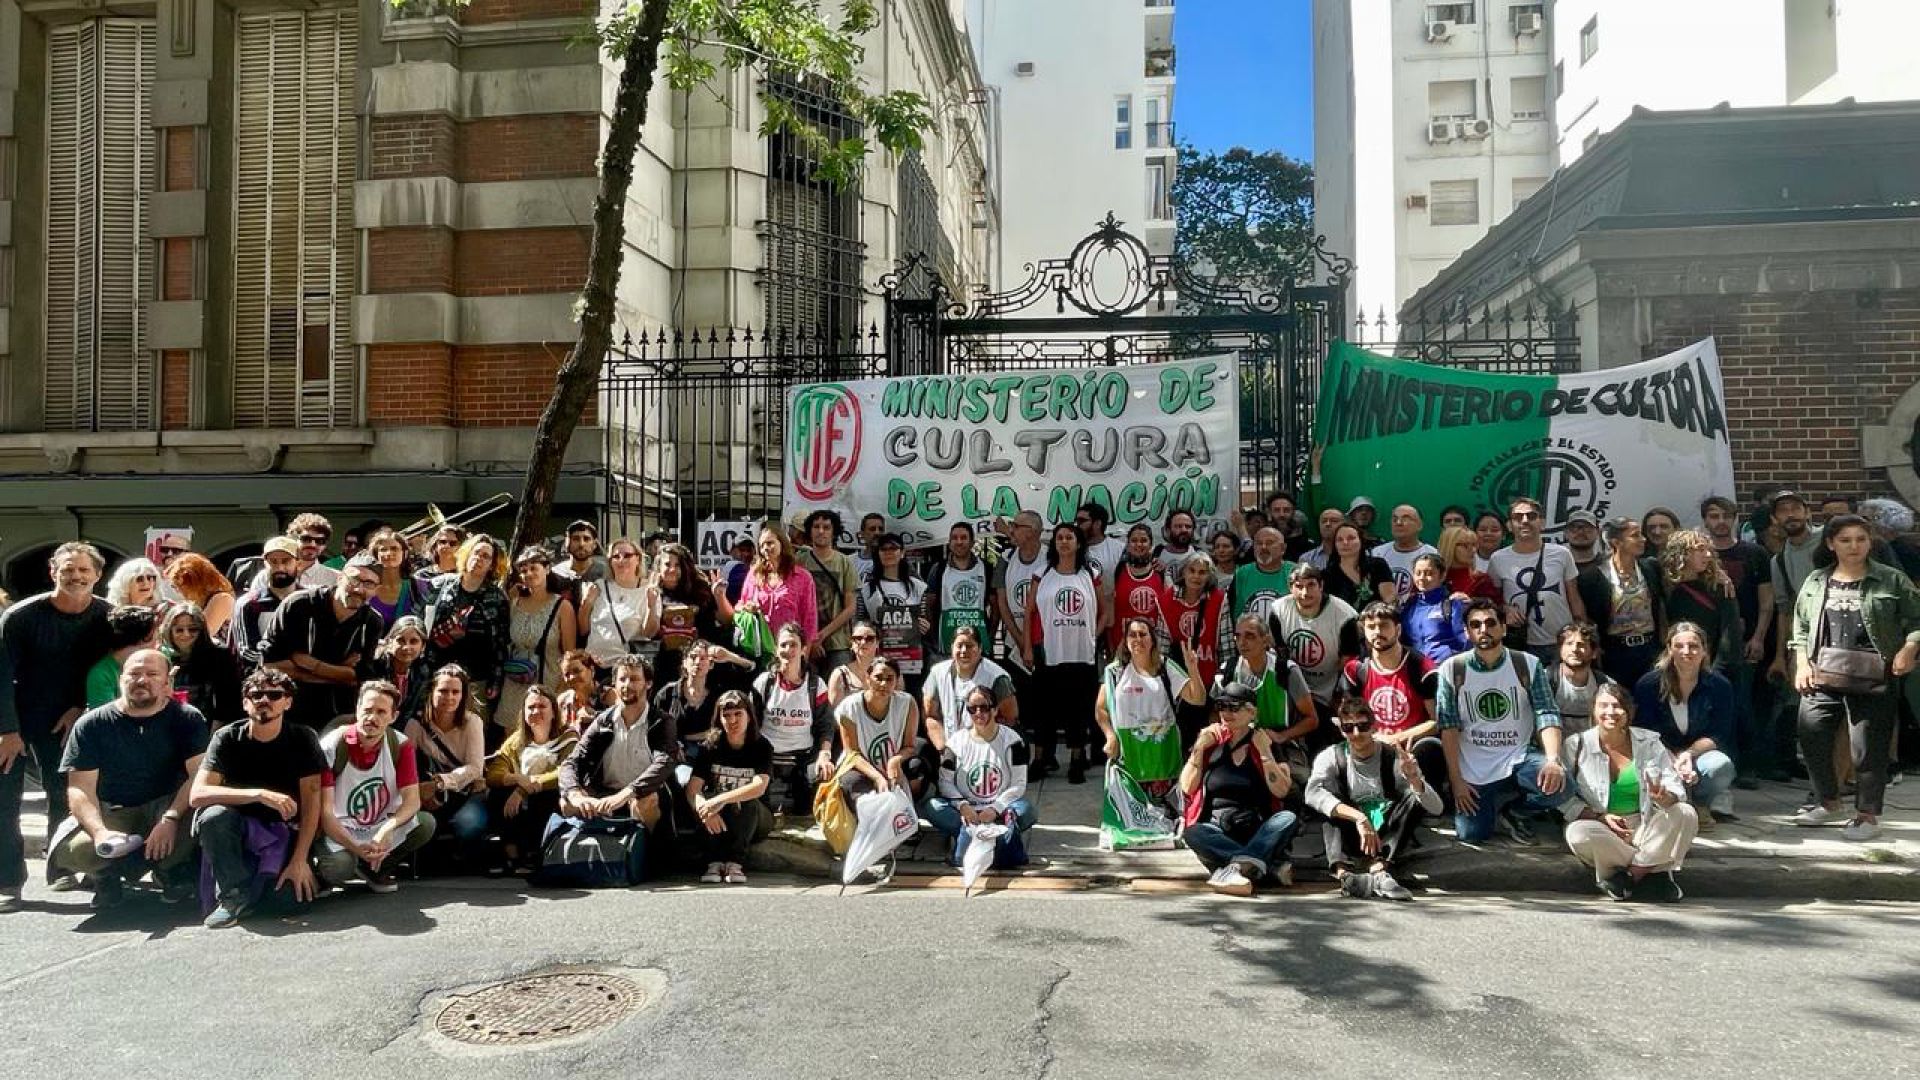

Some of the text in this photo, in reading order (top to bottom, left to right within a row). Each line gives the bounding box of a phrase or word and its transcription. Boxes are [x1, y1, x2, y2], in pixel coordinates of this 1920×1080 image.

[1159, 363, 1217, 414] DE
[1326, 357, 1728, 446] MINISTERIO DE CULTURA
[883, 422, 1212, 475] CULTURA
[1470, 437, 1553, 491] FORTALECER
[1557, 438, 1575, 449] EL
[887, 477, 947, 521] DE
[961, 483, 1021, 519] LA
[1498, 458, 1587, 526] ATE
[881, 607, 913, 625] ACÁ
[1057, 588, 1082, 614] ATE
[1131, 588, 1154, 611] ATE
[1290, 634, 1322, 666] ATE
[1479, 691, 1508, 719] ATE
